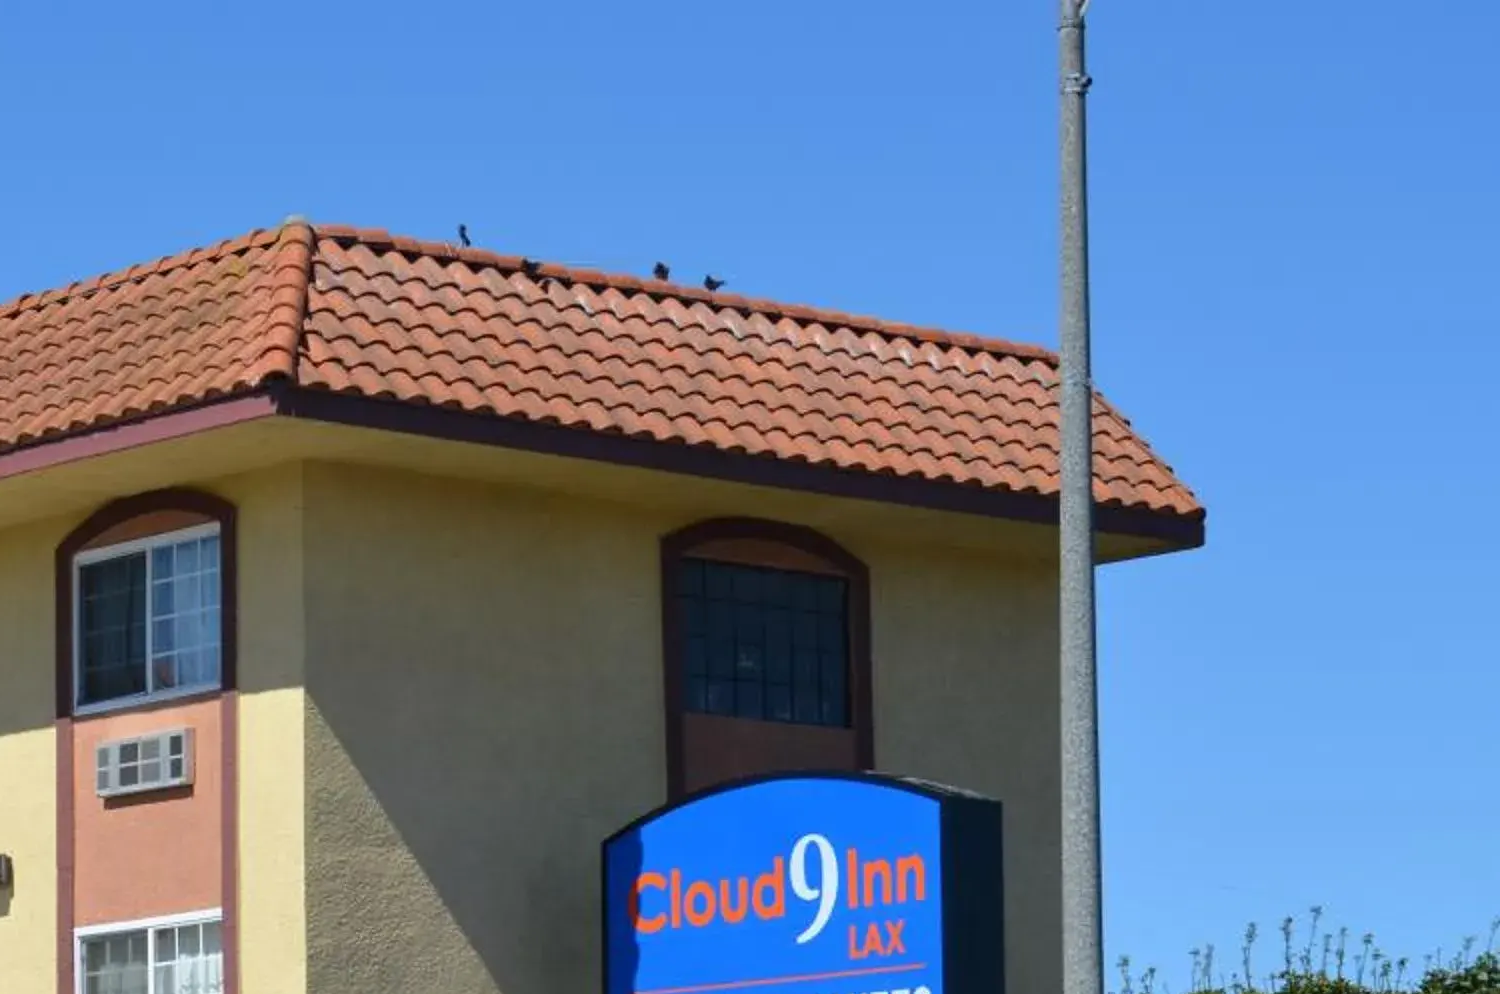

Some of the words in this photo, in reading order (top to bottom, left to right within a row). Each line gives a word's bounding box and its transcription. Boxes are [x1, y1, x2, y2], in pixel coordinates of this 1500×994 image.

[628, 855, 785, 933] Cloud
[789, 833, 838, 943] 9
[847, 848, 925, 908] Inn
[849, 921, 904, 959] LAX
